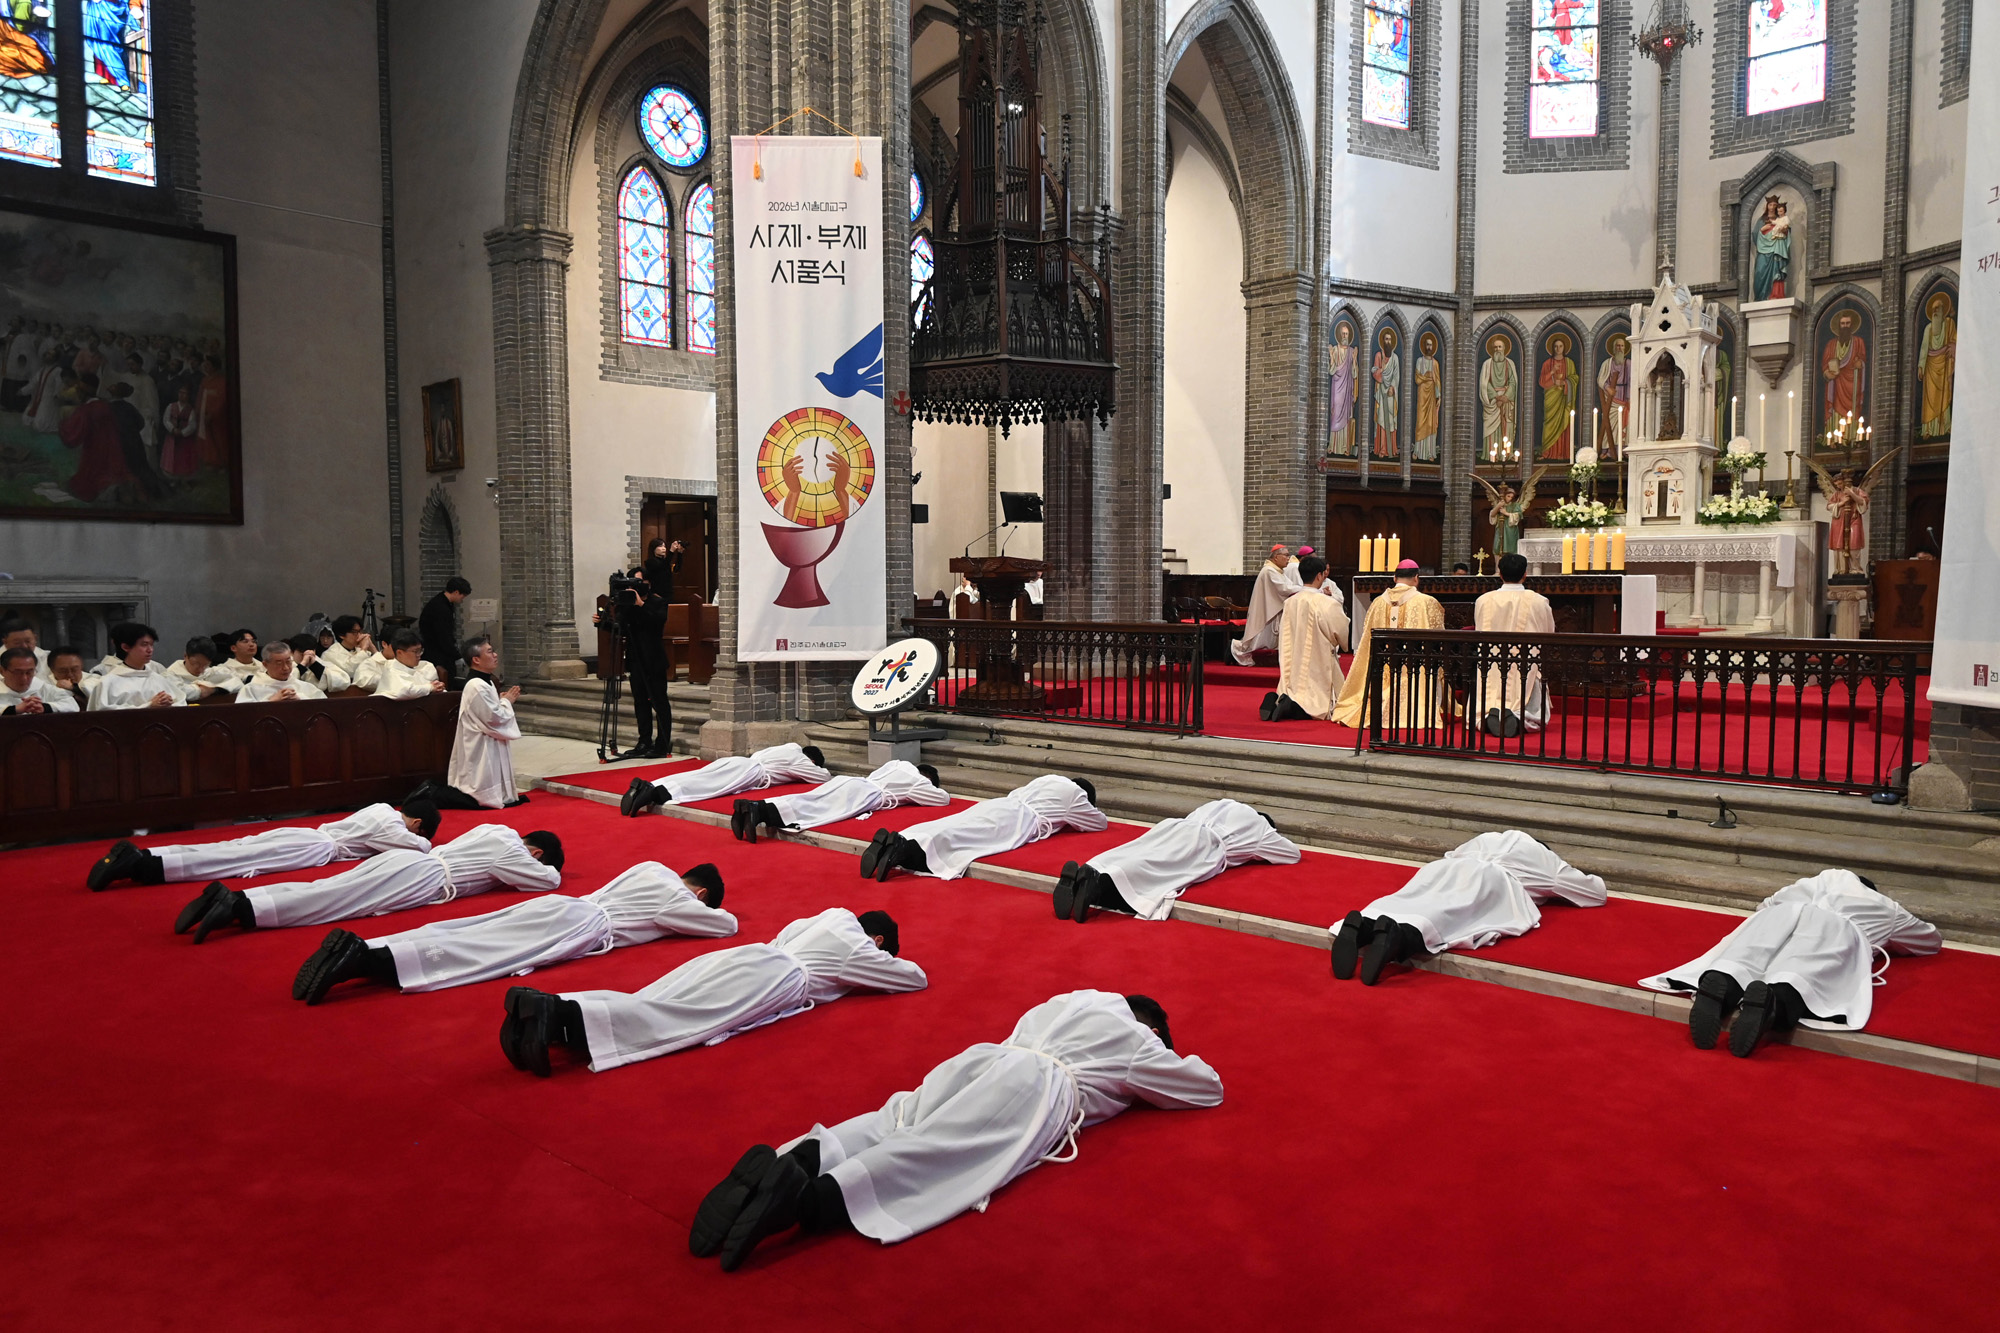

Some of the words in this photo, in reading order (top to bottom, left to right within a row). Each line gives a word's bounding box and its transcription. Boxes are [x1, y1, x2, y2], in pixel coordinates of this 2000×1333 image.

[768, 201, 800, 212] 2026년
[801, 200, 848, 212] 서울대교구
[770, 259, 846, 285] 서품식
[1977, 252, 2000, 273] 자기
